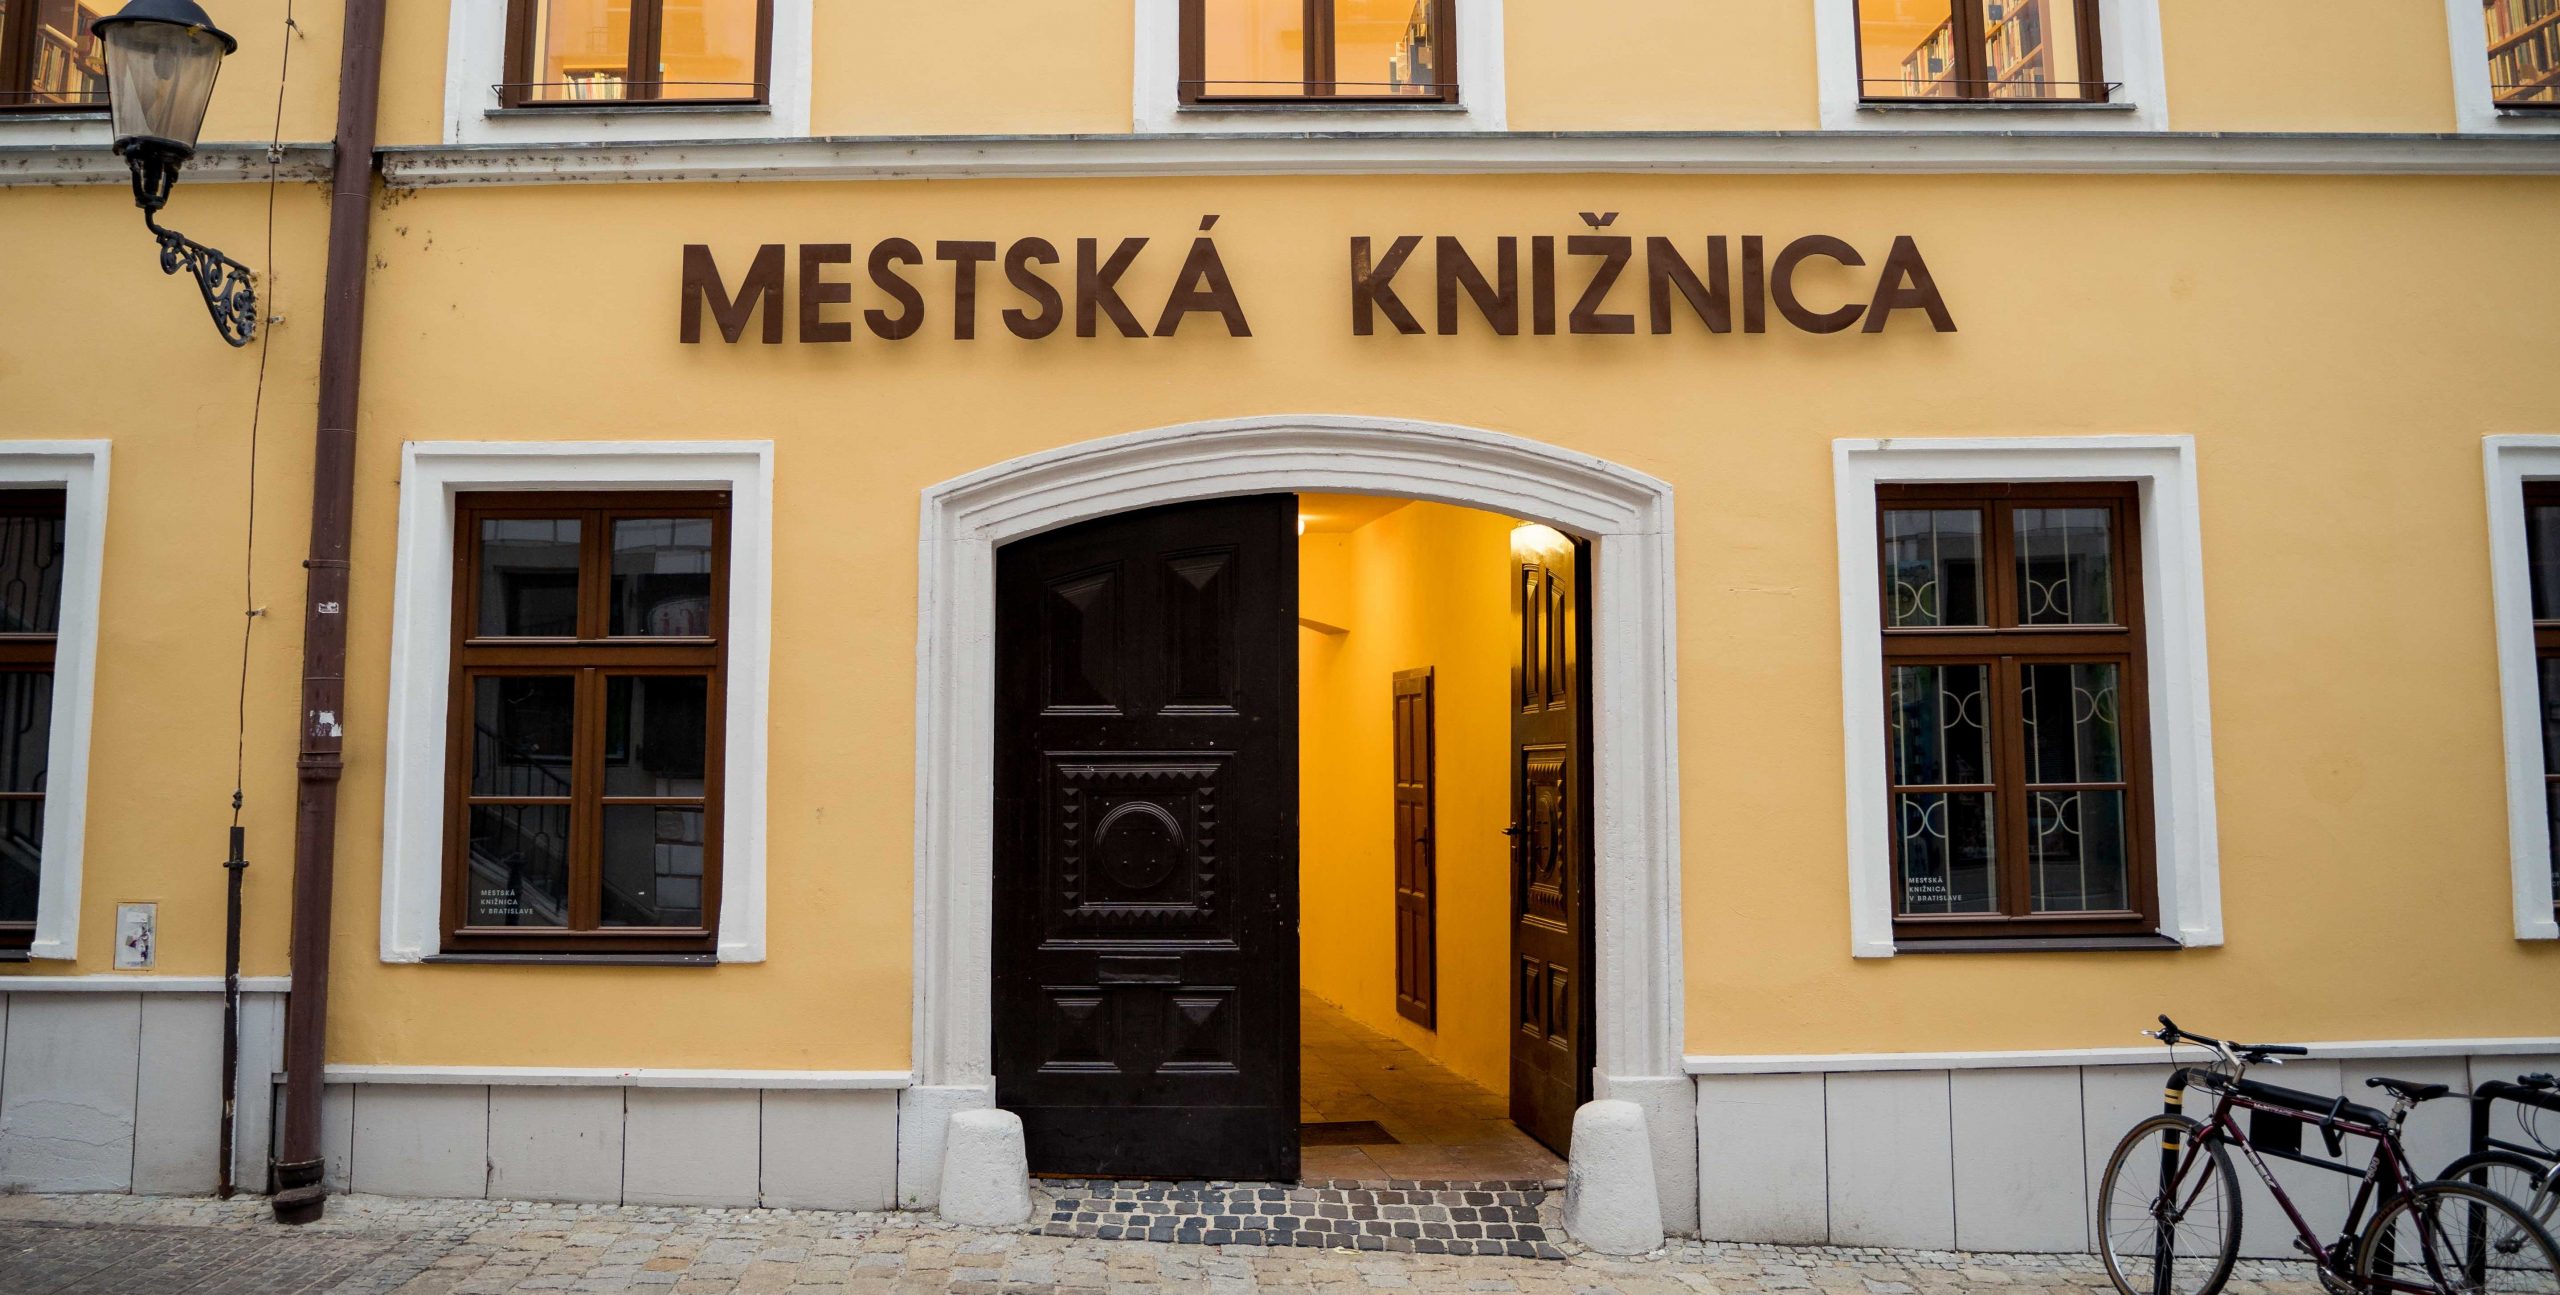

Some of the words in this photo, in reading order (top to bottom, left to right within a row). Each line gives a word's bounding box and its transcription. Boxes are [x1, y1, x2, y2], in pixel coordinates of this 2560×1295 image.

[680, 215, 1252, 344] MESTSKÁ
[1351, 213, 1957, 336] KNIŽNICA
[1908, 876, 1943, 884] MESTSKÁ
[1909, 885, 1946, 893] KNIŽNICA
